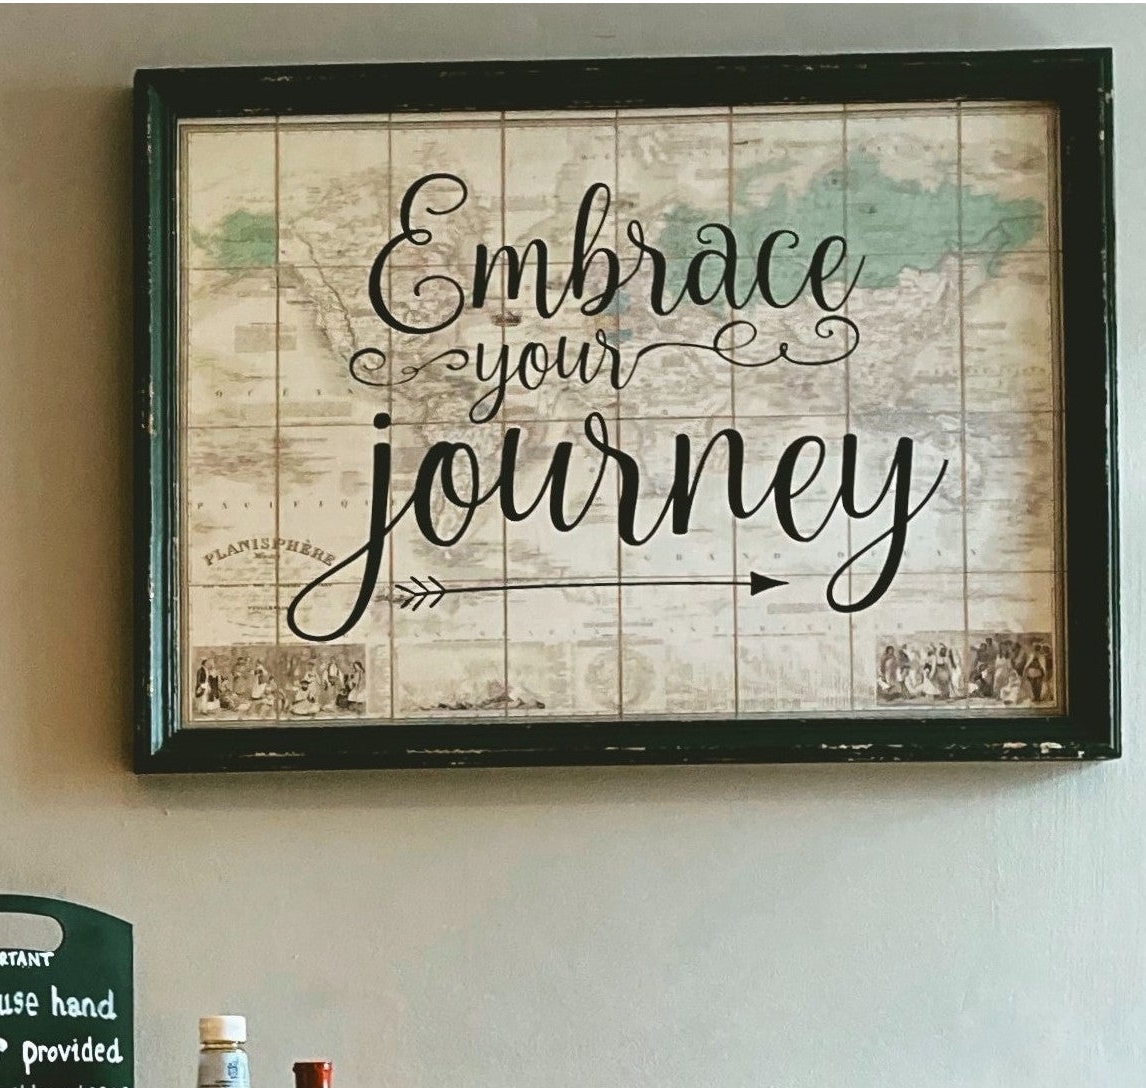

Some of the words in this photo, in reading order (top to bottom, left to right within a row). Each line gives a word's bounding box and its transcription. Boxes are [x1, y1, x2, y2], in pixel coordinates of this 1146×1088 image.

[367, 173, 866, 335] Embrace
[286, 411, 949, 642] journey
[203, 537, 337, 567] PLANISPHÈRE
[51, 985, 118, 1020] hand
[22, 1035, 123, 1075] provided
